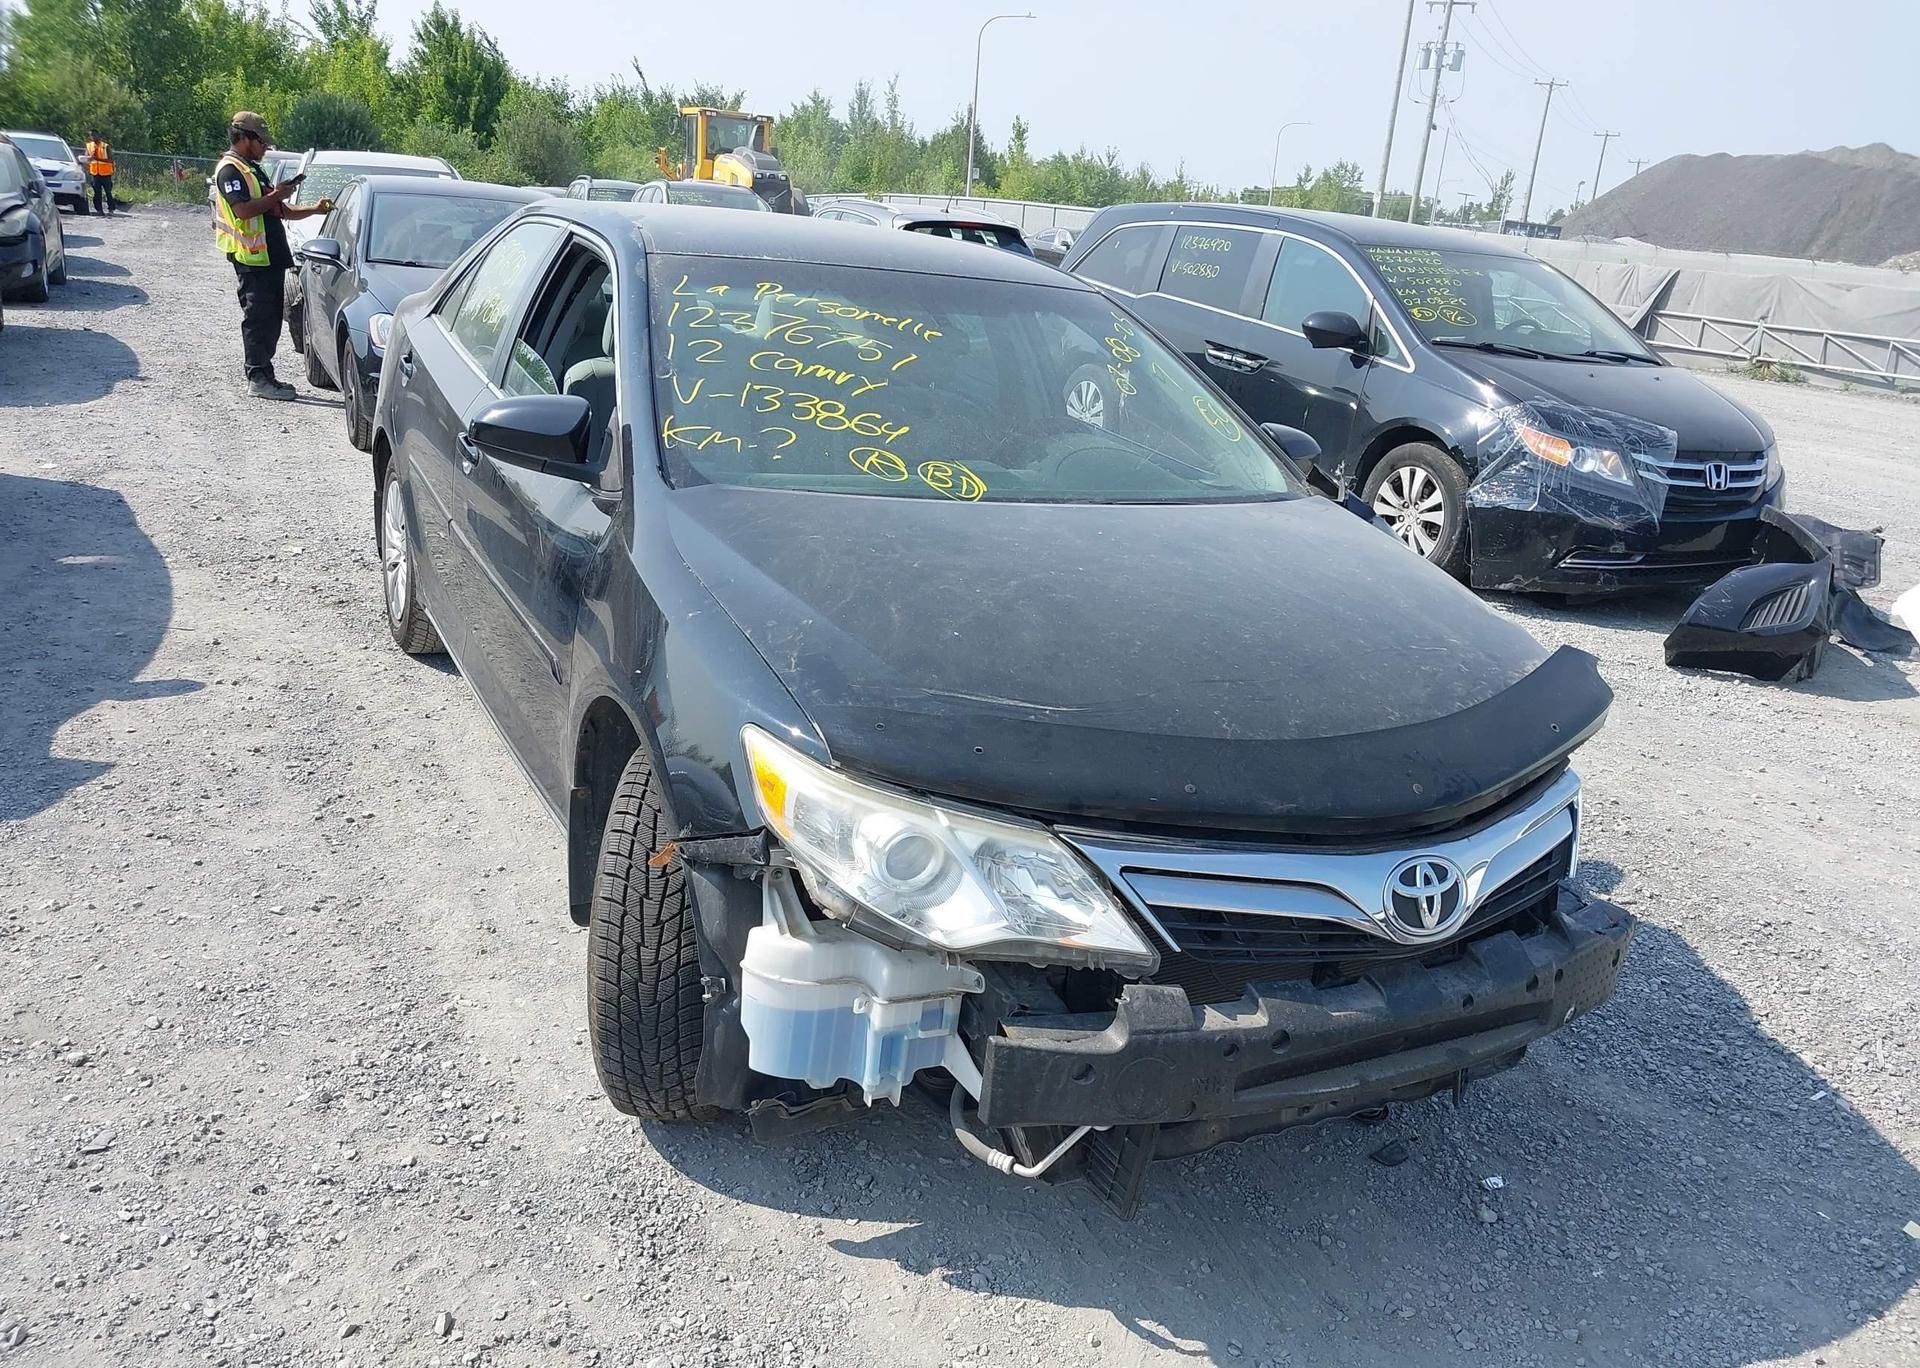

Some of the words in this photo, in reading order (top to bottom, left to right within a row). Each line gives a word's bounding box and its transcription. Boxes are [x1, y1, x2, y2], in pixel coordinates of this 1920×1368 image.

[672, 275, 731, 297] La
[667, 334, 727, 363] 12
[668, 302, 918, 371] 12376751
